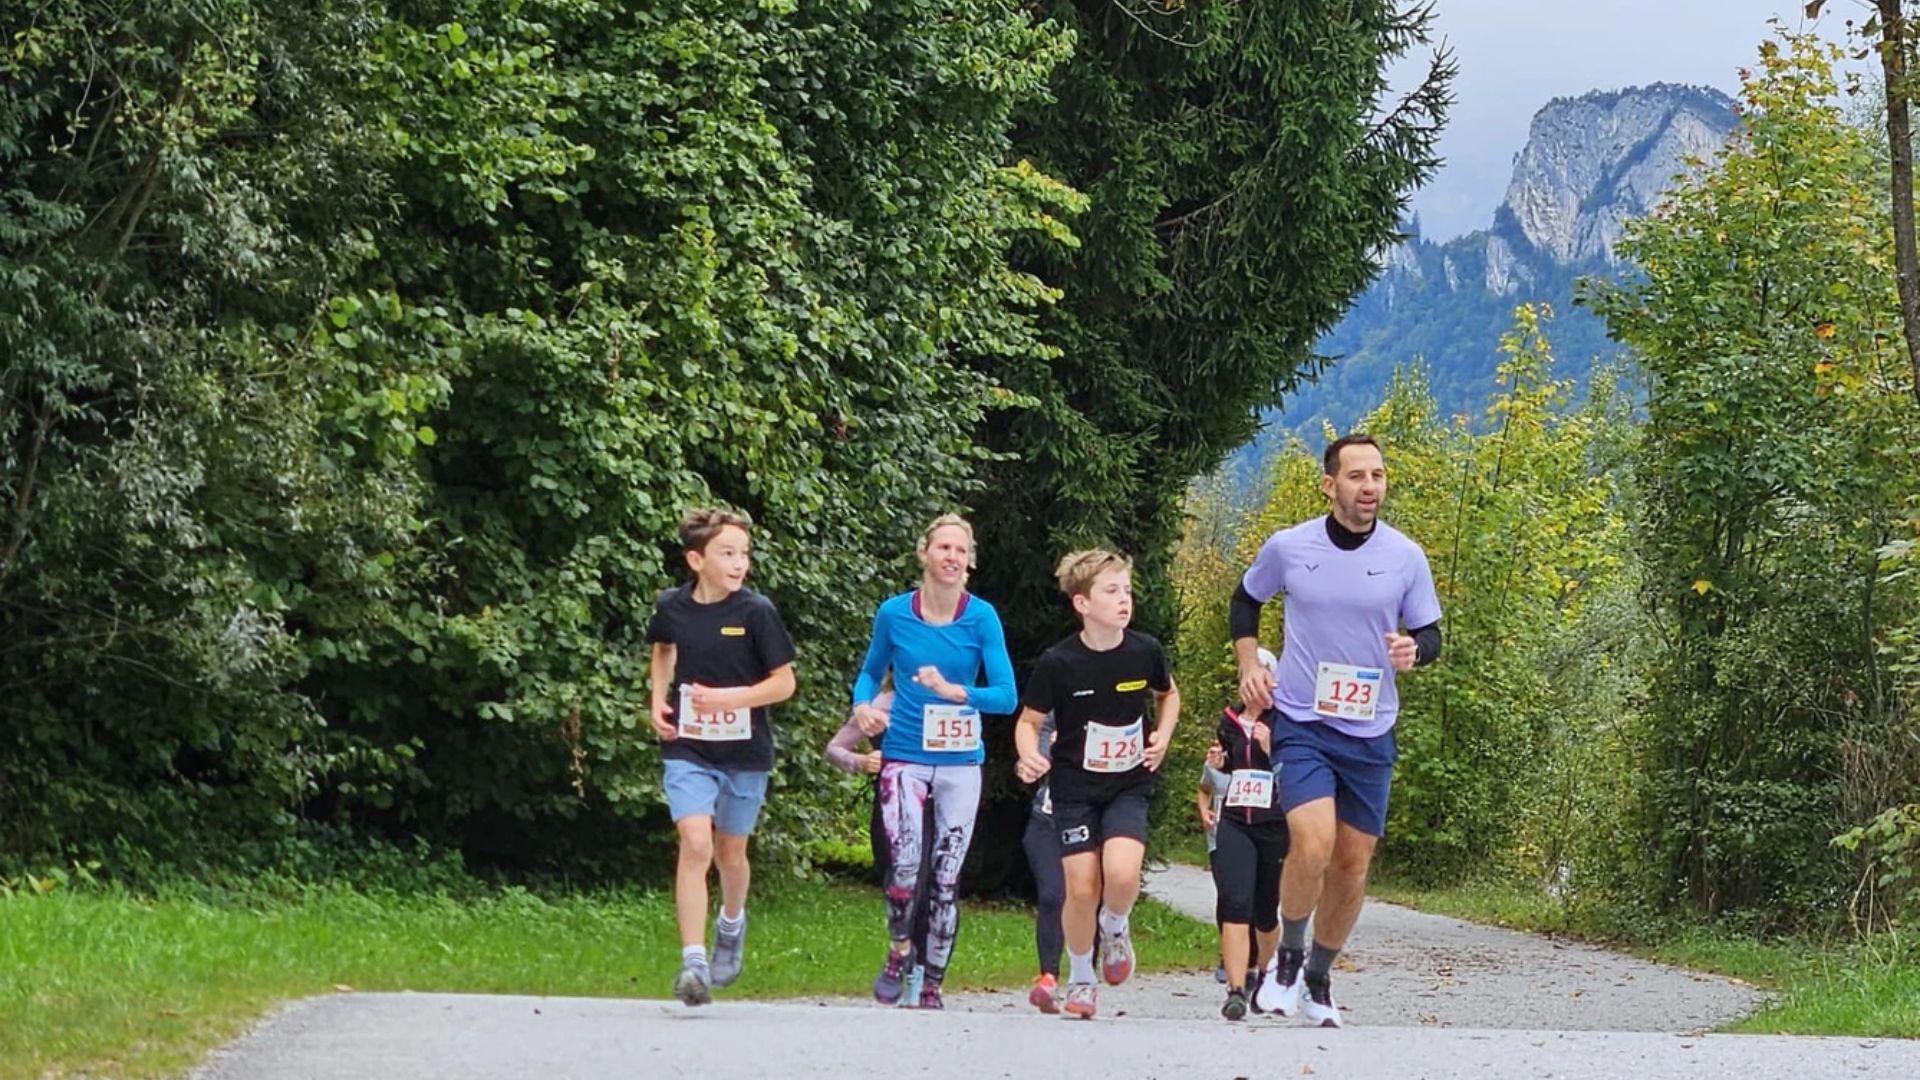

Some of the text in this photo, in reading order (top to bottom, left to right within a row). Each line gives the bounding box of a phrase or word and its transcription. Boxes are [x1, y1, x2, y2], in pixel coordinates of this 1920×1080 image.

[1329, 680, 1372, 704] 123
[937, 719, 973, 738] 151
[1234, 780, 1263, 796] 144
